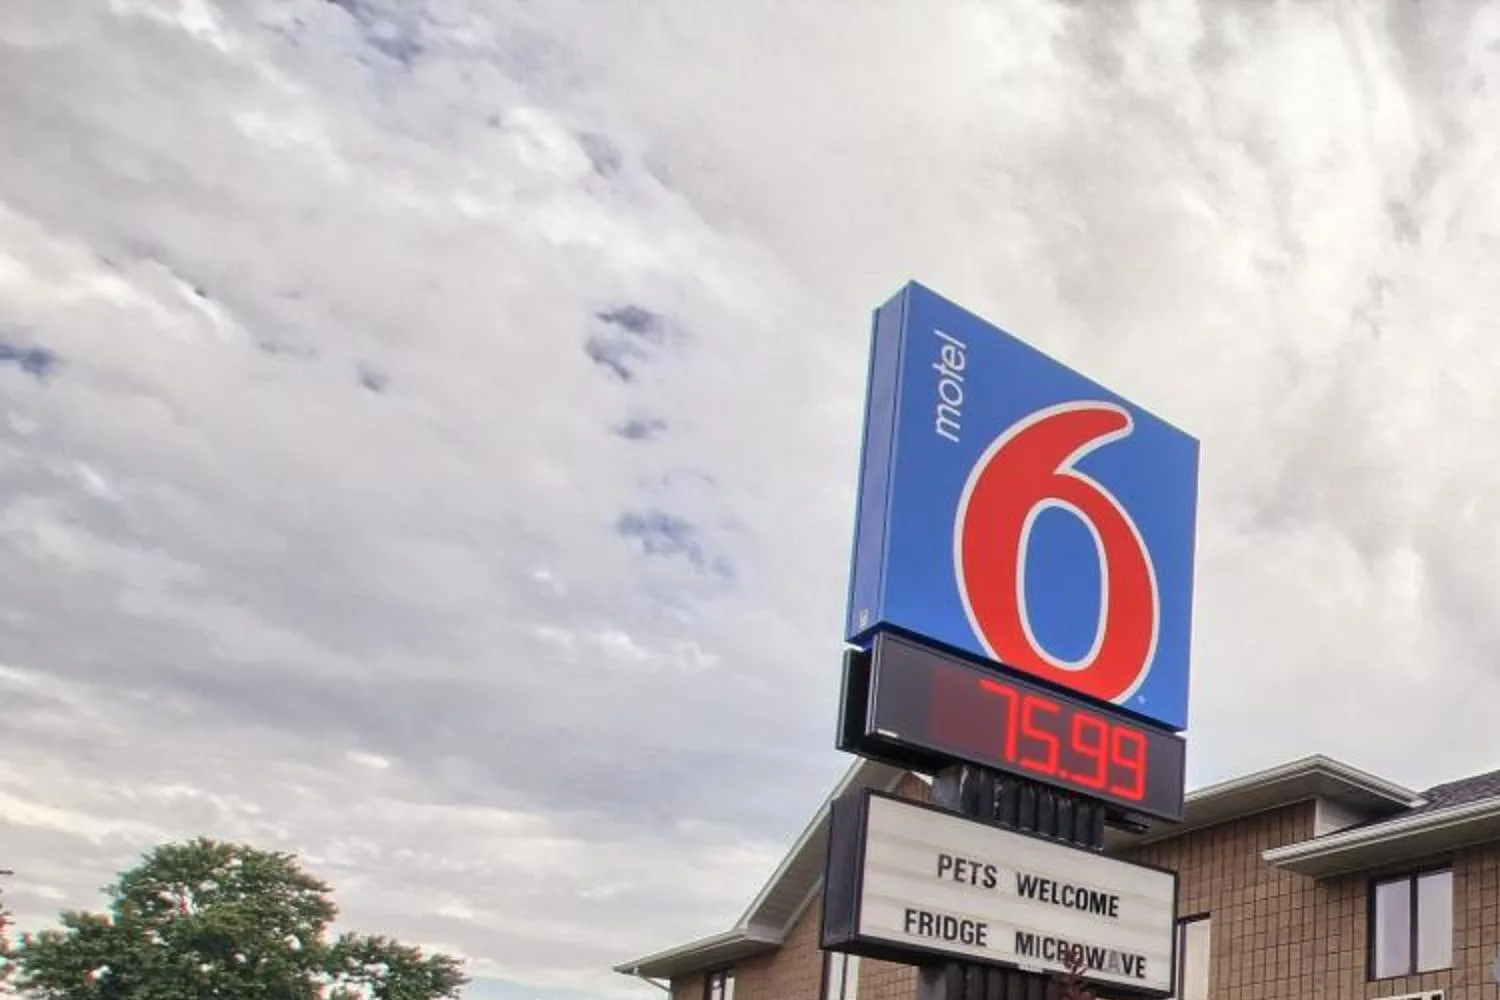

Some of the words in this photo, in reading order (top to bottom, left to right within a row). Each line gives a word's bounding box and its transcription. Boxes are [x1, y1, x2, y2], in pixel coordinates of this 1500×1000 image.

[933, 329, 968, 443] motel
[953, 399, 1160, 704] 6
[937, 853, 998, 890] PETS
[1016, 871, 1120, 918] WELCOME
[904, 907, 988, 947] FRIDGE
[1015, 931, 1147, 979] MICROWAVE
